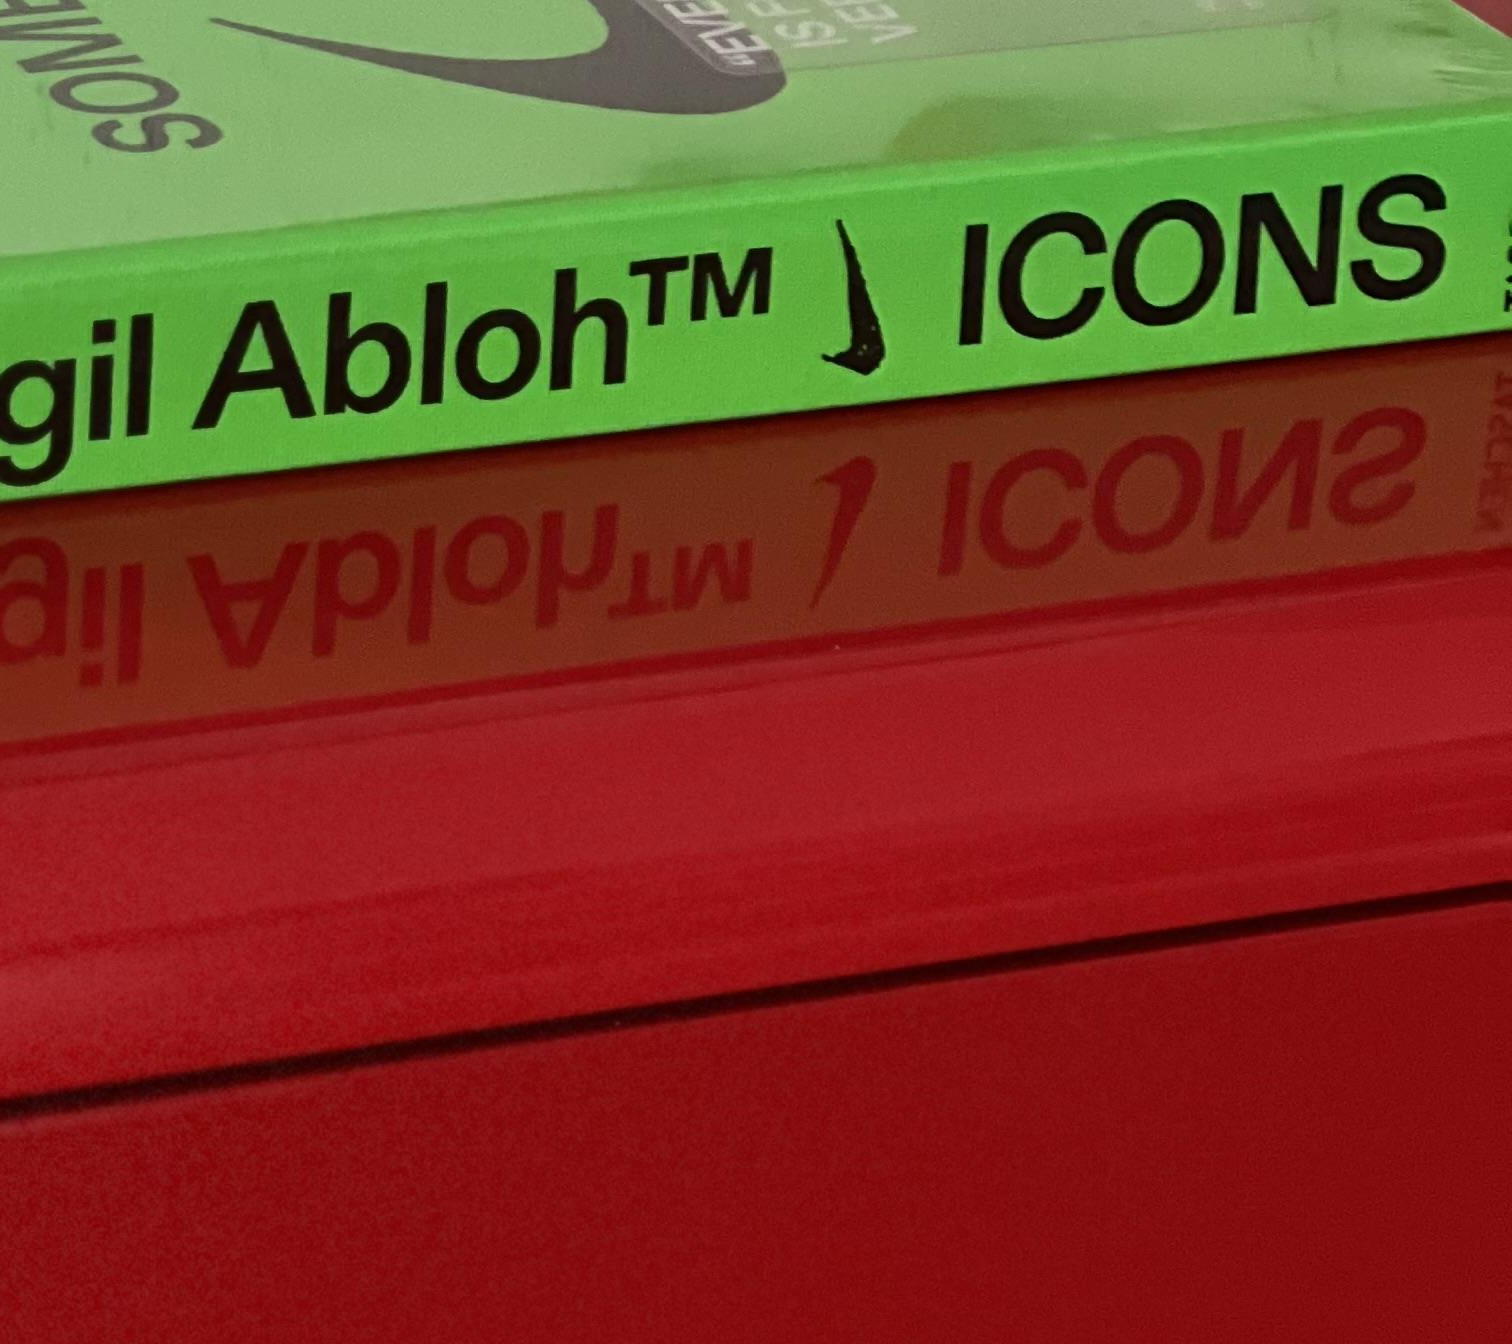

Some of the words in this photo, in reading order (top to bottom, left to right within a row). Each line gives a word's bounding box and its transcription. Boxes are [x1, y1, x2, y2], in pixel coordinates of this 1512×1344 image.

[774, 20, 849, 48] IS
[191, 247, 774, 430] Abloh™
[959, 173, 1447, 346] ICONS
